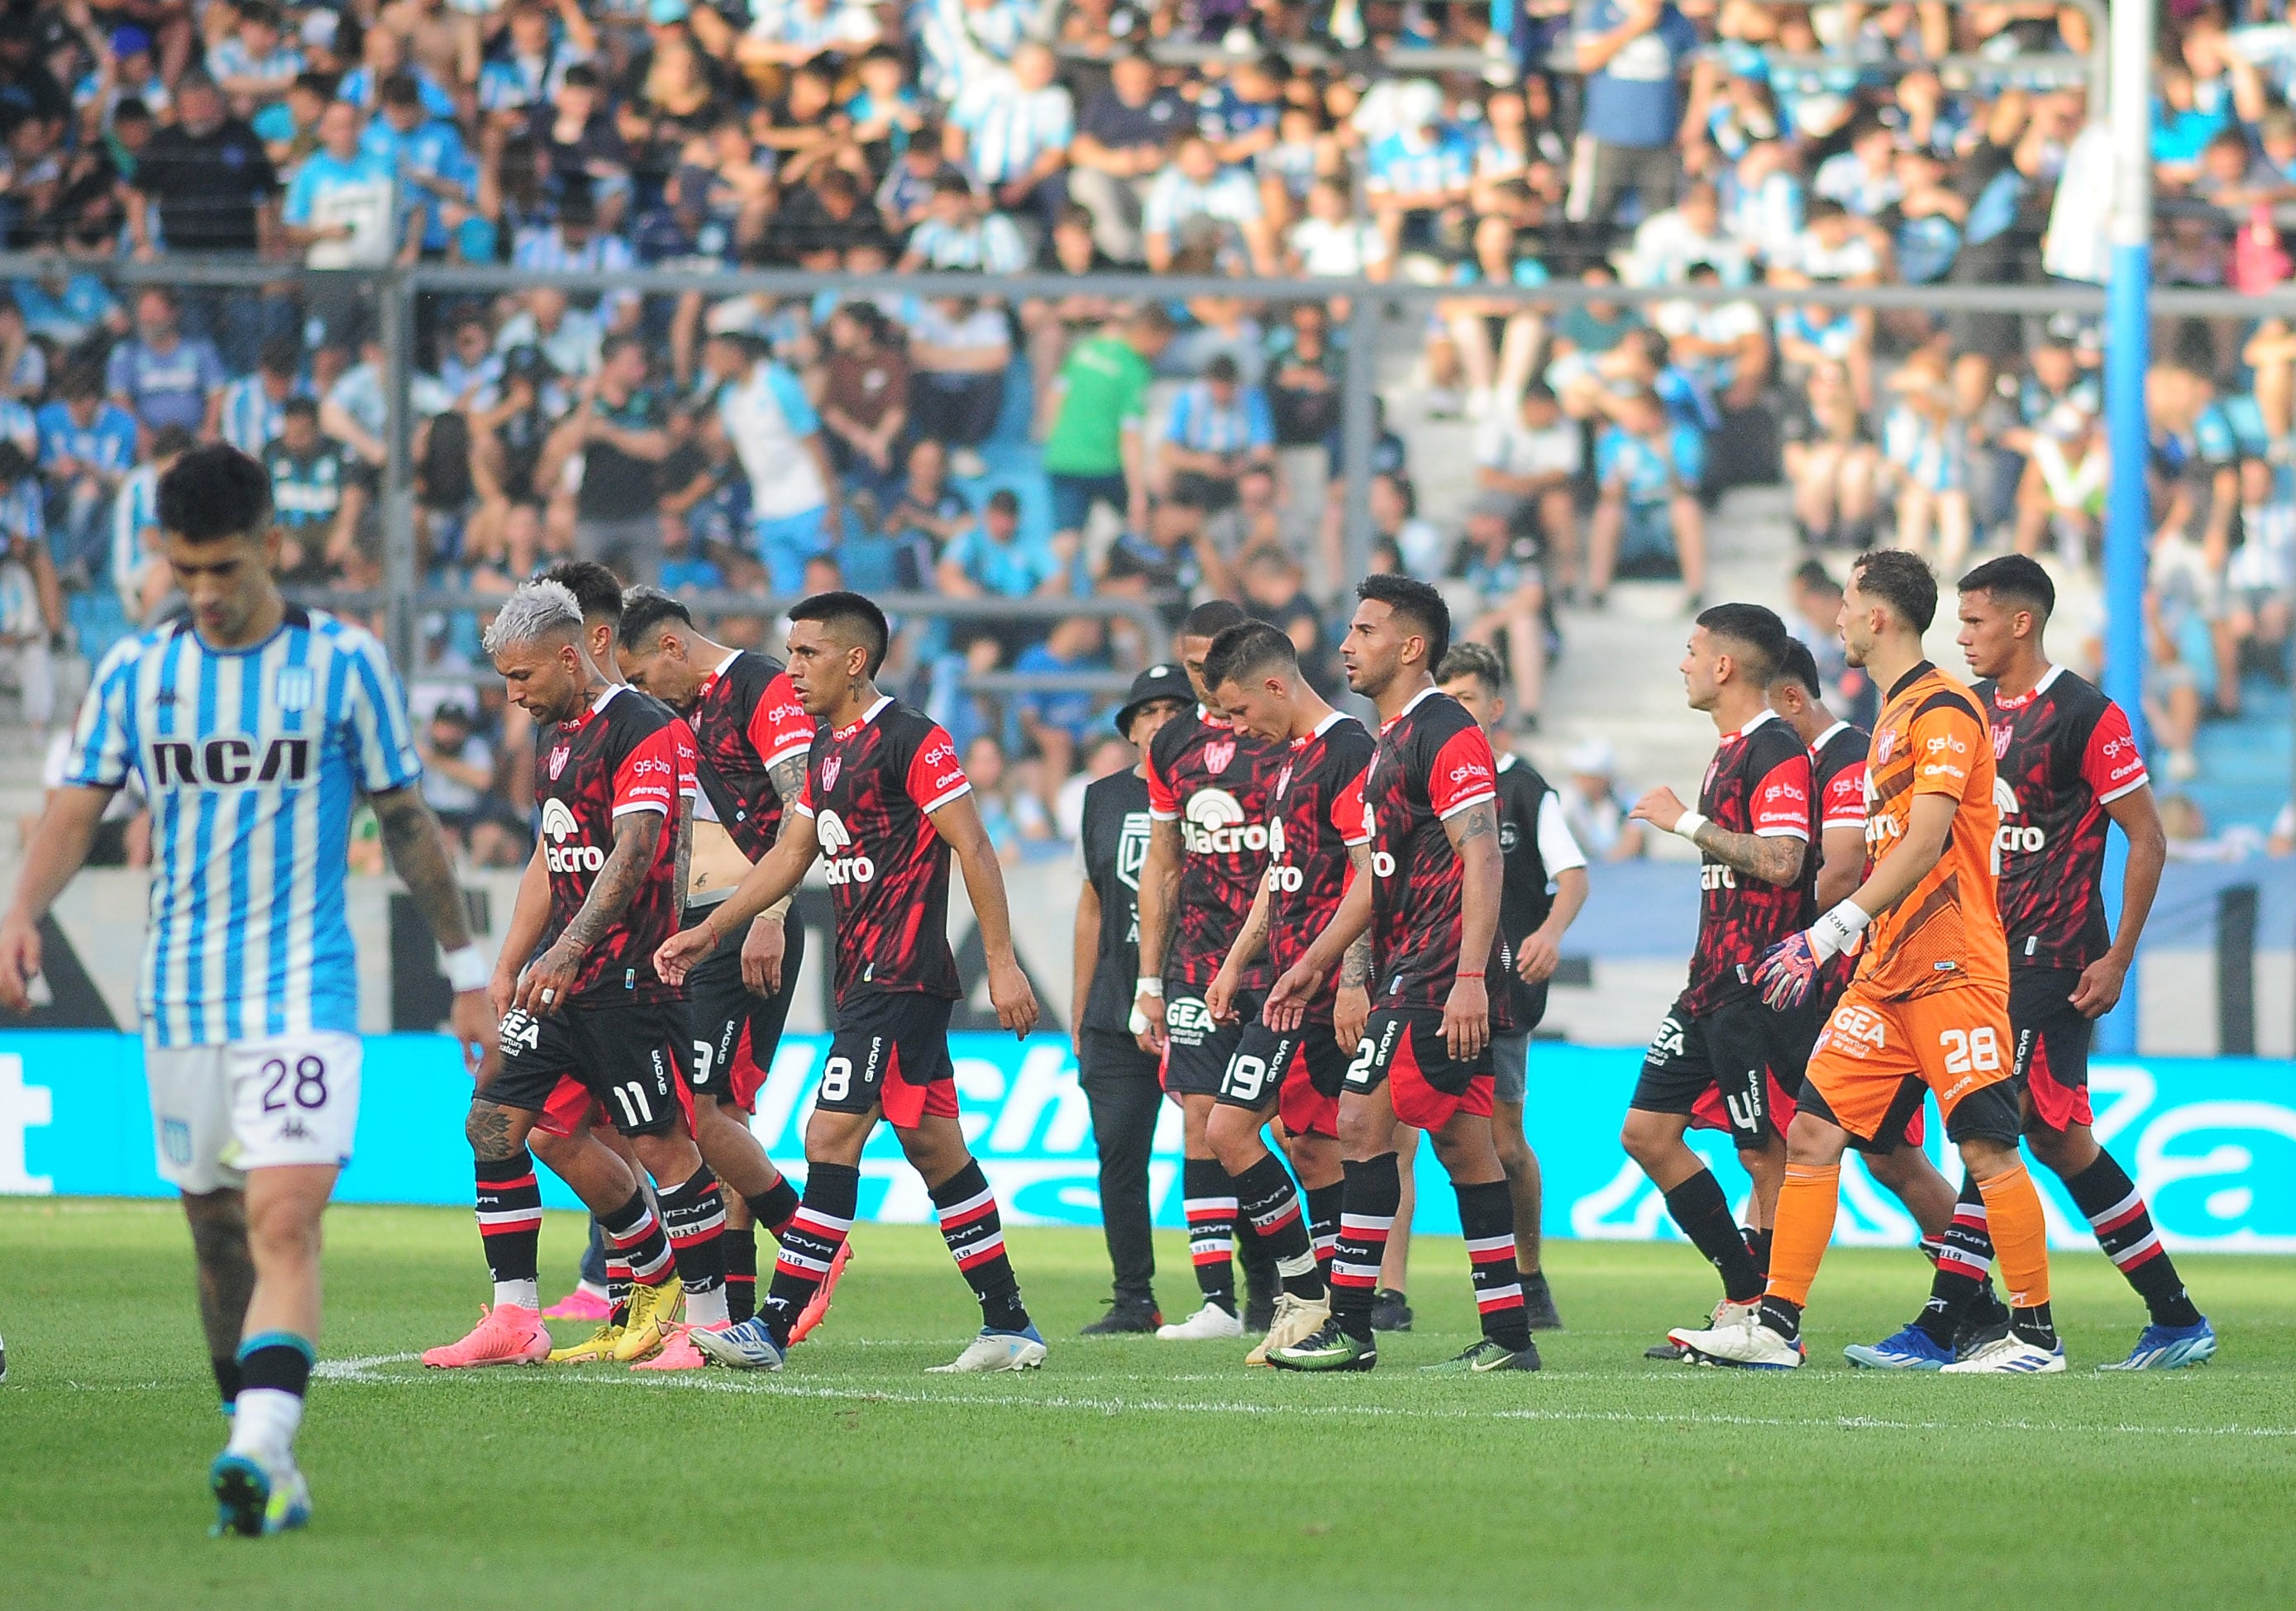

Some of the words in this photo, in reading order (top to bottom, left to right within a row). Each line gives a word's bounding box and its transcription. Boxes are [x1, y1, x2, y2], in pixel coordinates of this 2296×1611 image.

[153, 739, 308, 784] RCA
[824, 856, 875, 885] acro
[1167, 1003, 1216, 1032] GEA
[1834, 1008, 1885, 1049] GEA
[1654, 1024, 1684, 1056] EA
[1940, 1027, 2000, 1074] 28
[262, 1056, 327, 1111] 28
[822, 1057, 852, 1101] 8
[613, 1081, 653, 1127] 11
